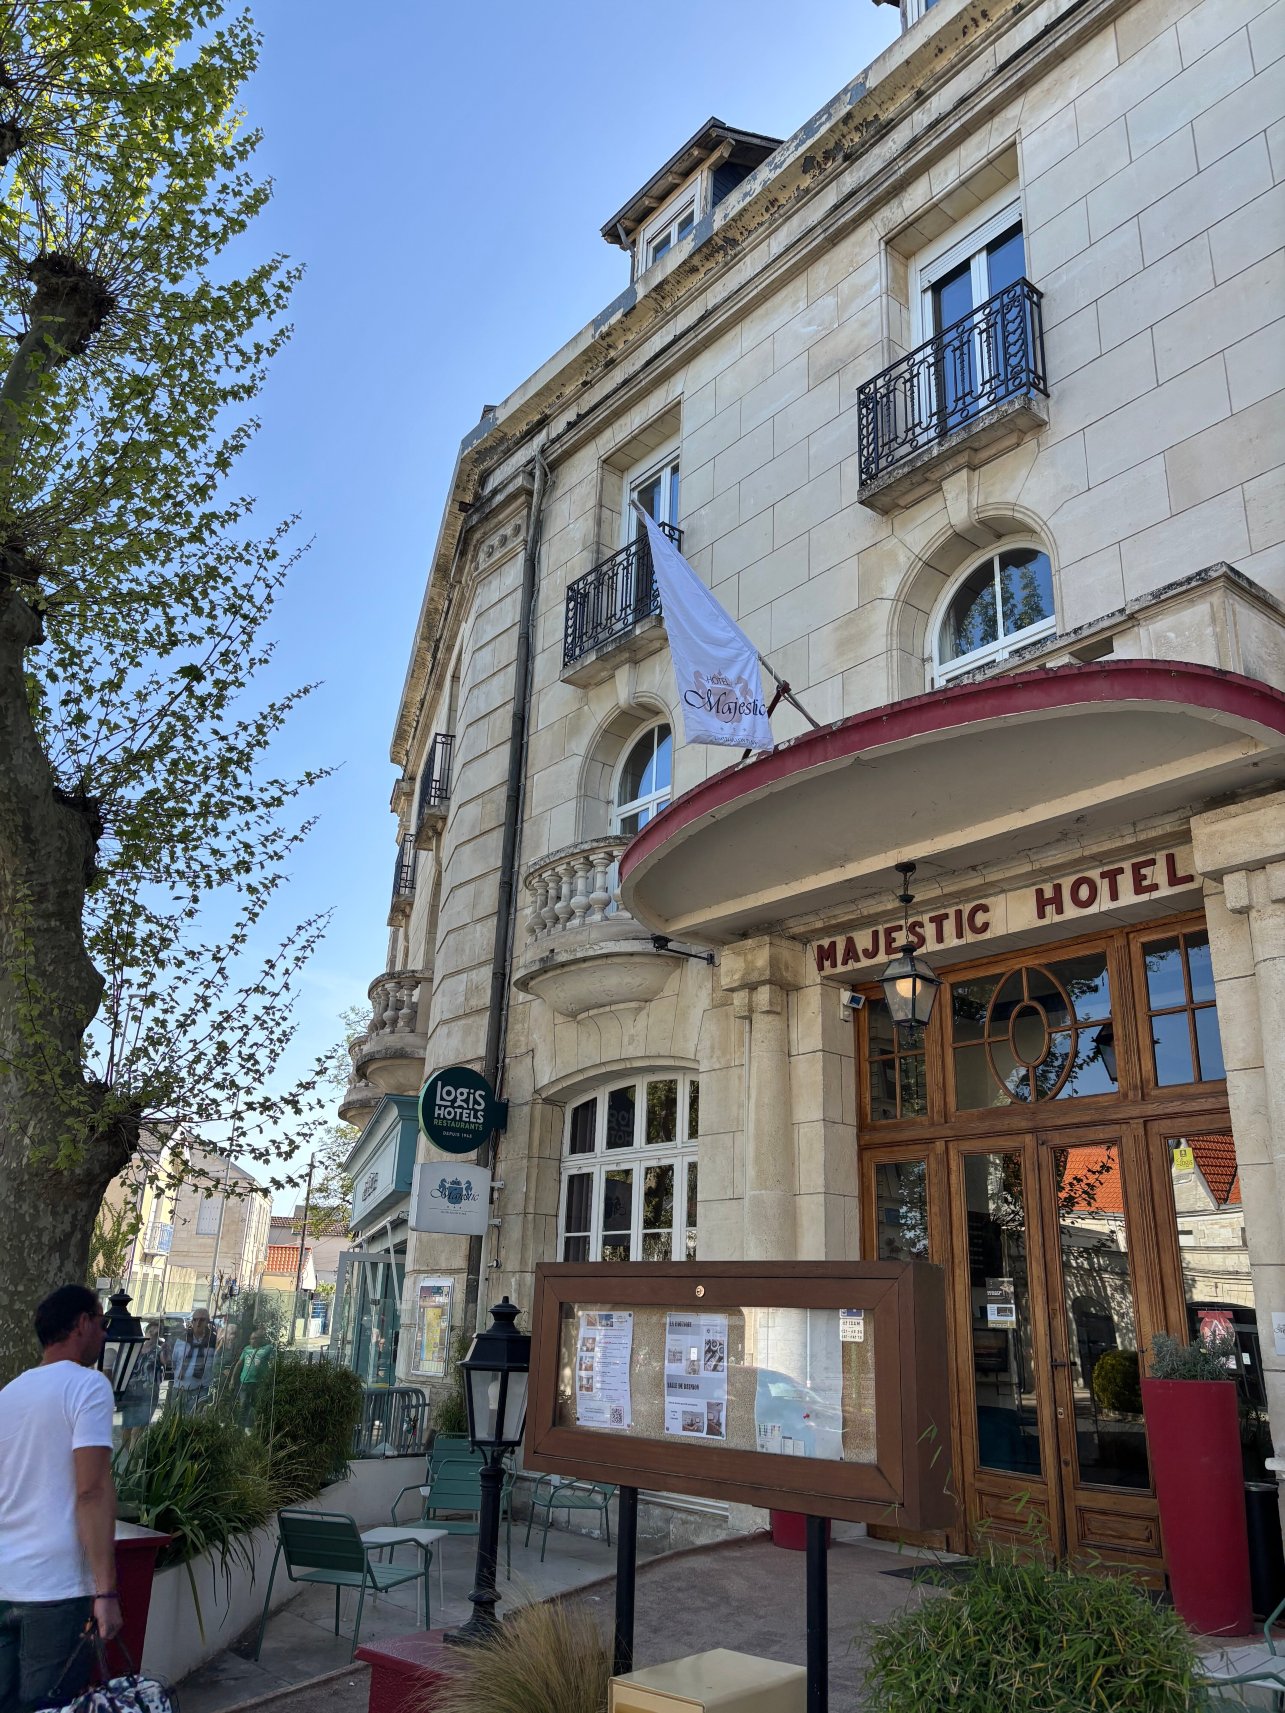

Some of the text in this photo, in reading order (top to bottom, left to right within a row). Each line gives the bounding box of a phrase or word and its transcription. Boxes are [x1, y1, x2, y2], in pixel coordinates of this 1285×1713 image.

[706, 674, 731, 686] HOTEL
[684, 689, 767, 723] Majestic
[816, 852, 1195, 971] MAJESTIC HOTEL
[434, 1105, 485, 1123] HOTELS
[433, 1119, 483, 1131] RESTAURANTS
